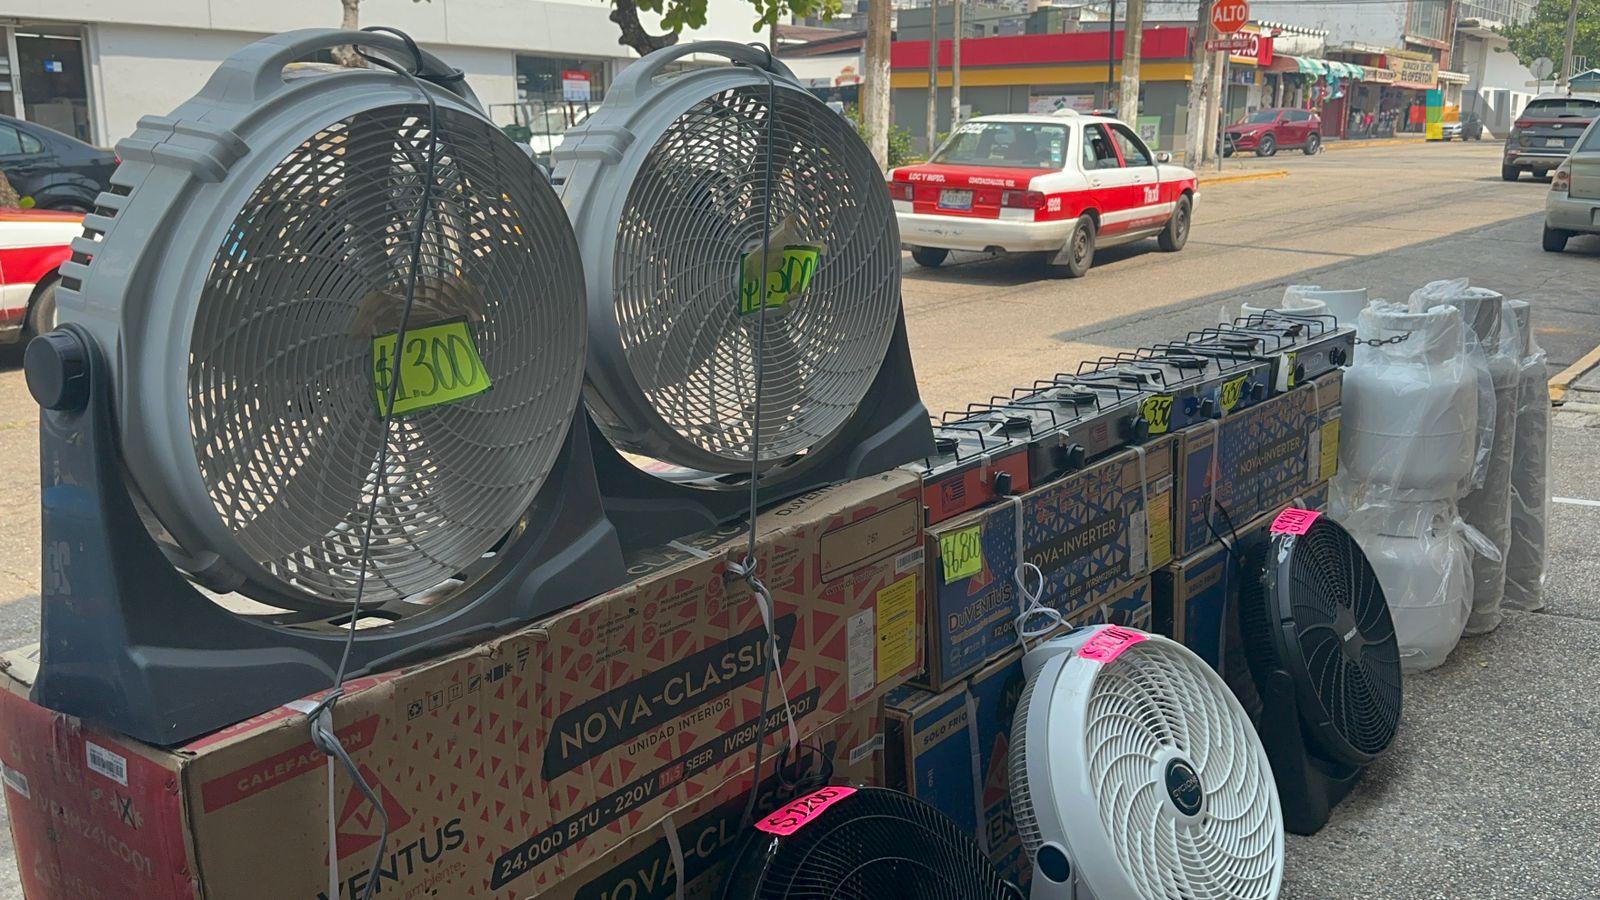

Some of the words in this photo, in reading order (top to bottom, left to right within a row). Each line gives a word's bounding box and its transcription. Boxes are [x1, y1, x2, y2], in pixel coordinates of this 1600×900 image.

[1213, 5, 1246, 22] ALTO
[908, 172, 921, 181] LOC
[921, 173, 927, 182] Y
[1240, 438, 1301, 474] NOVA-INVERTER
[627, 726, 675, 756] UNIDAD
[678, 698, 731, 731] INTERIOR
[923, 726, 946, 746] SOLO
[501, 832, 563, 879] 24,000
[567, 811, 600, 840] BTU
[615, 779, 654, 815] 220V
[686, 749, 713, 772] SEER
